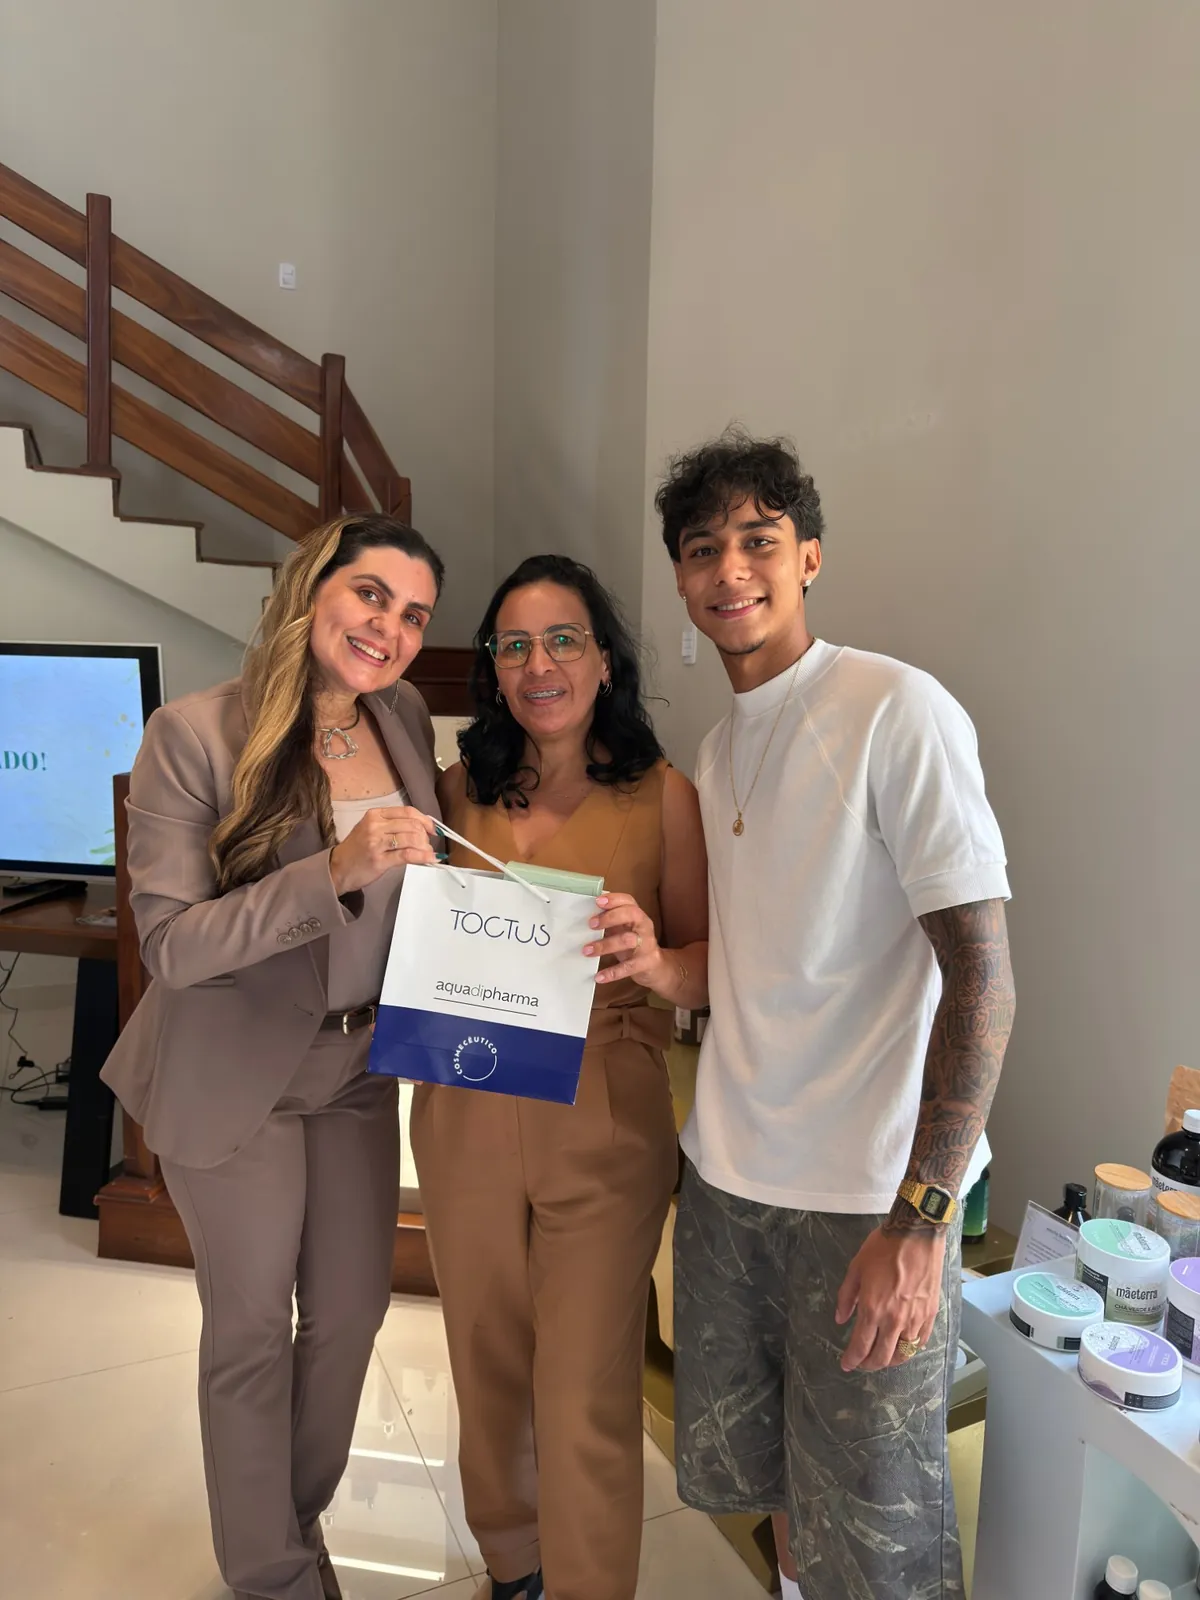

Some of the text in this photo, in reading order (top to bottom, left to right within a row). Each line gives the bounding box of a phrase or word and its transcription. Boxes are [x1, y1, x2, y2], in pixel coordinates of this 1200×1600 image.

[0, 750, 47, 771] DO!
[450, 909, 551, 947] TOCTUS
[435, 979, 540, 1008] aquadipharma
